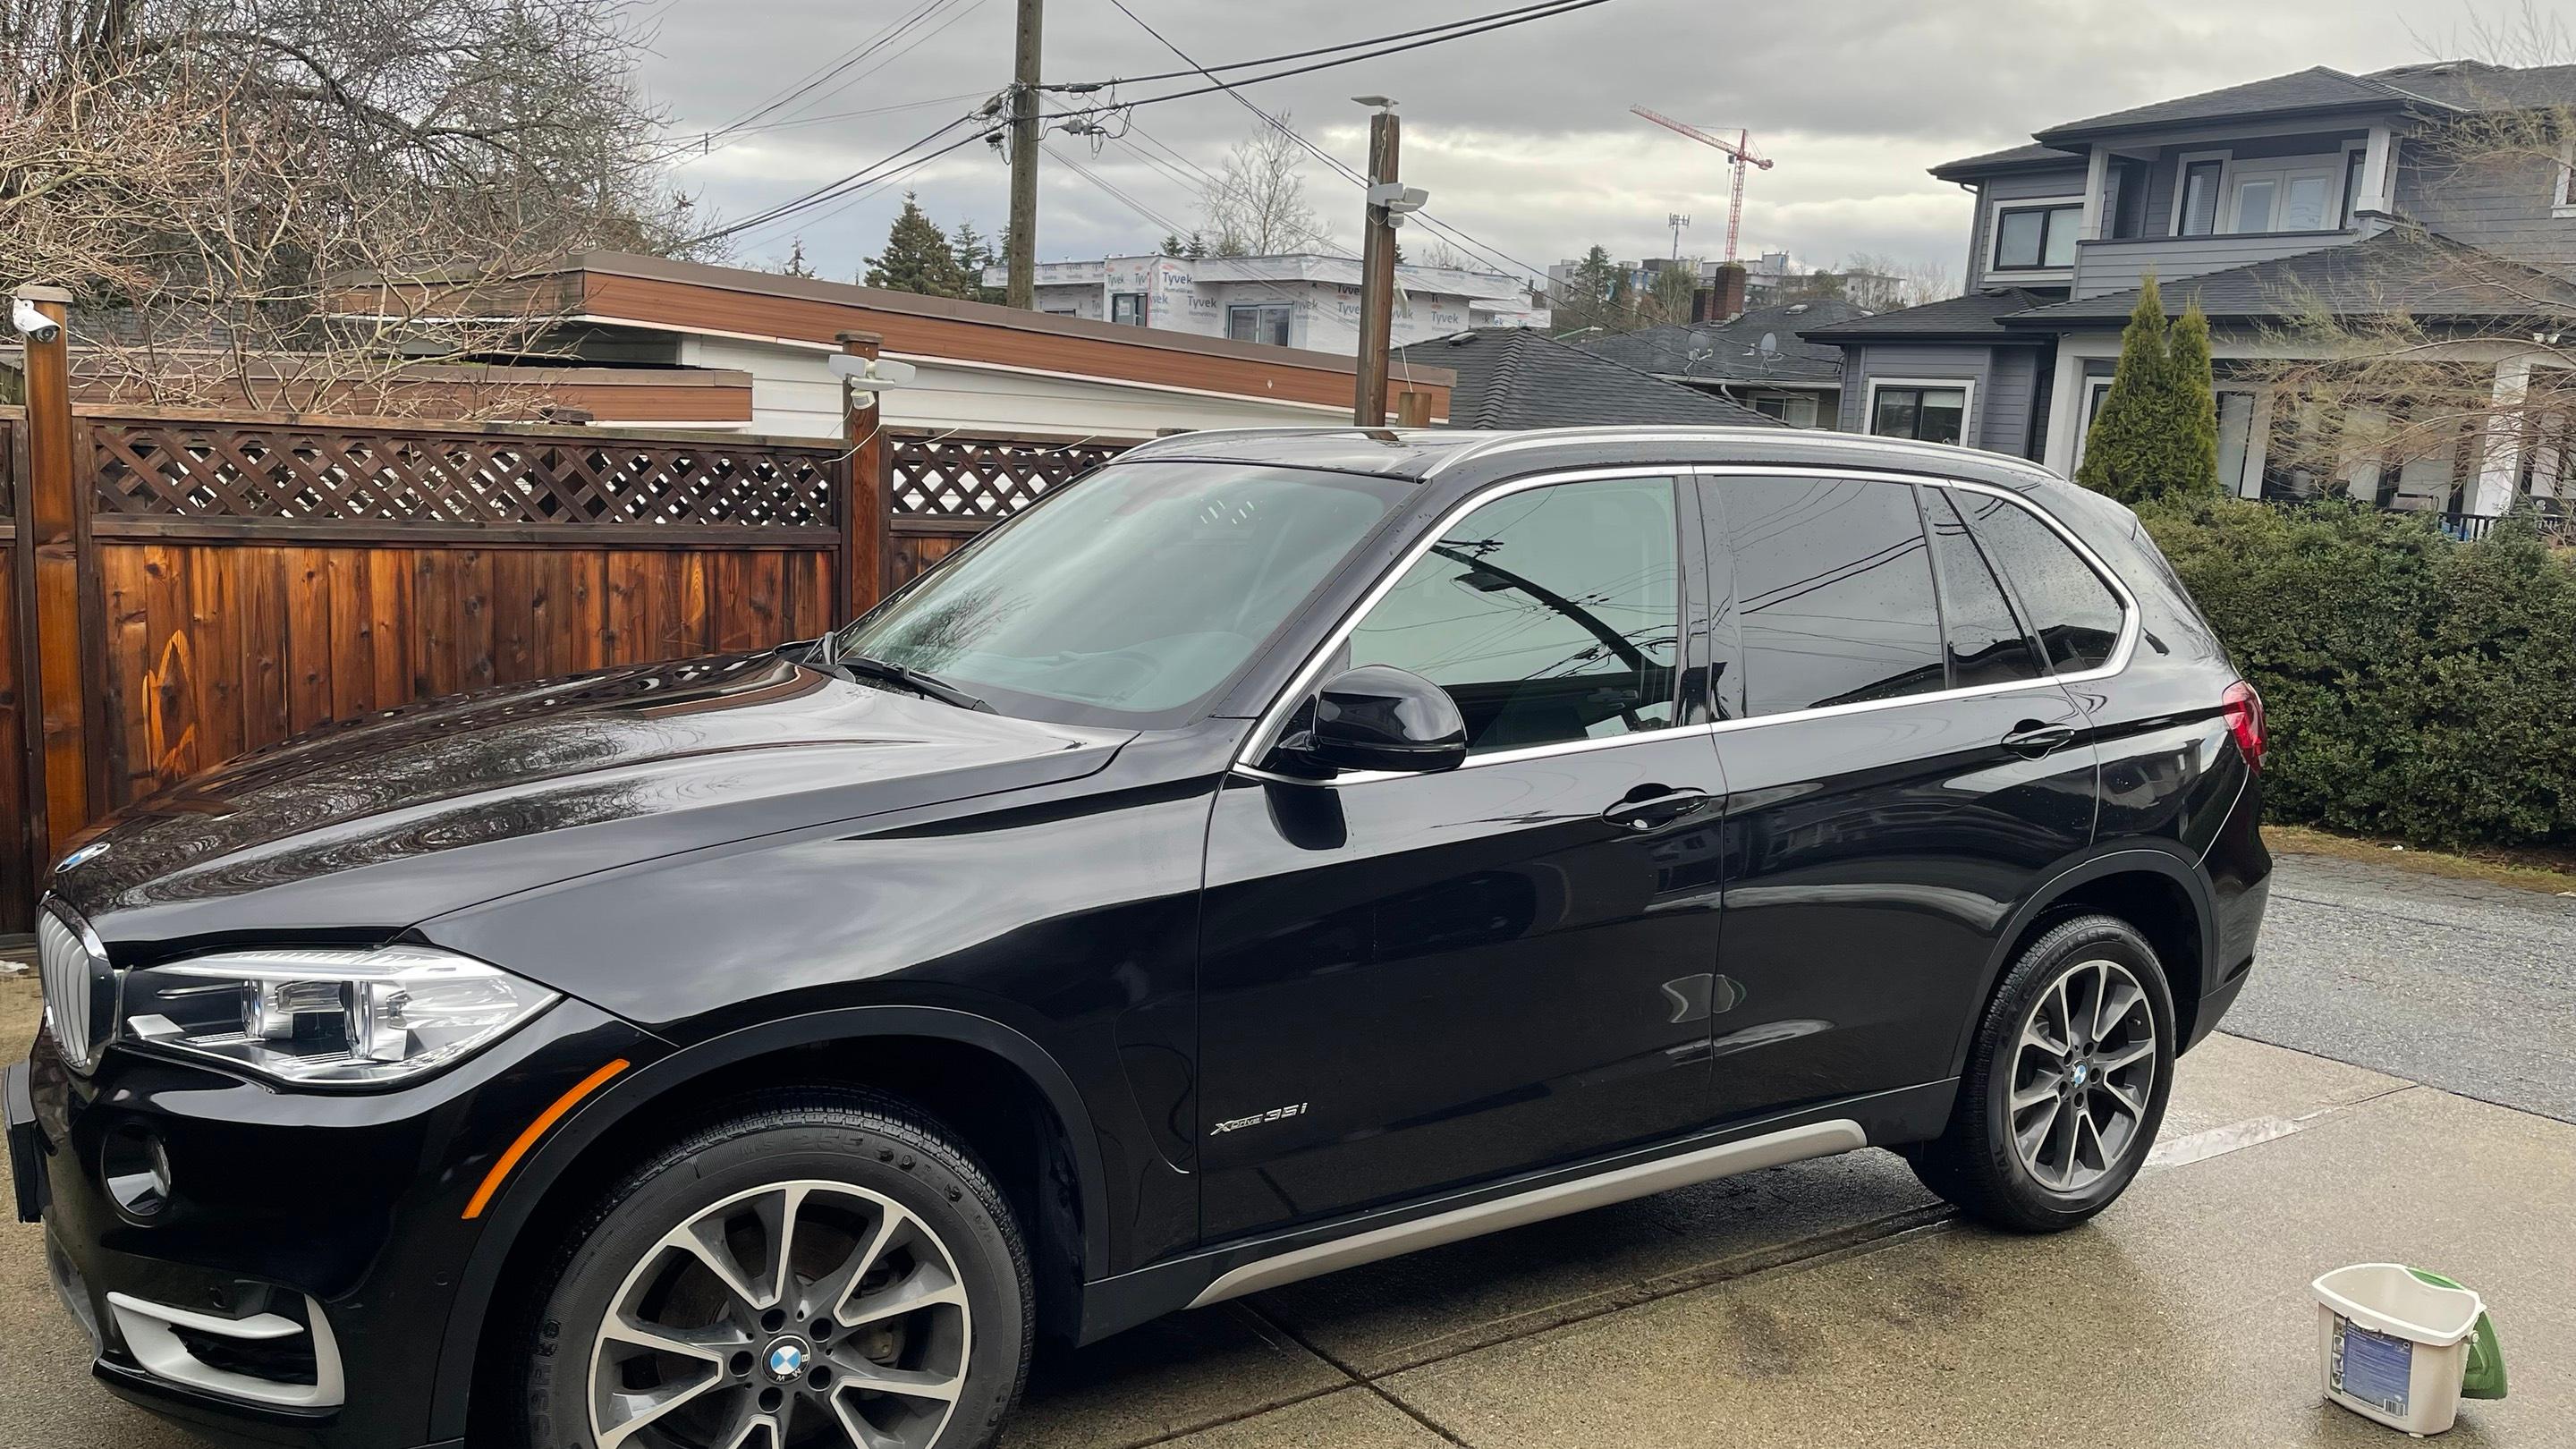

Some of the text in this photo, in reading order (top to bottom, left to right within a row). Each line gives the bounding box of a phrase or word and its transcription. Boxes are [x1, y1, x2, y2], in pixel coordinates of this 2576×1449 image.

[1107, 275, 1124, 286] Tyvek
[1135, 274, 1148, 286] Tyv
[1163, 272, 1192, 285] Tyvek
[1188, 296, 1216, 309] Tyvek
[1338, 302, 1360, 316] Tyve
[1431, 311, 1459, 325] Tyvek
[775, 1353, 809, 1382] BMW
